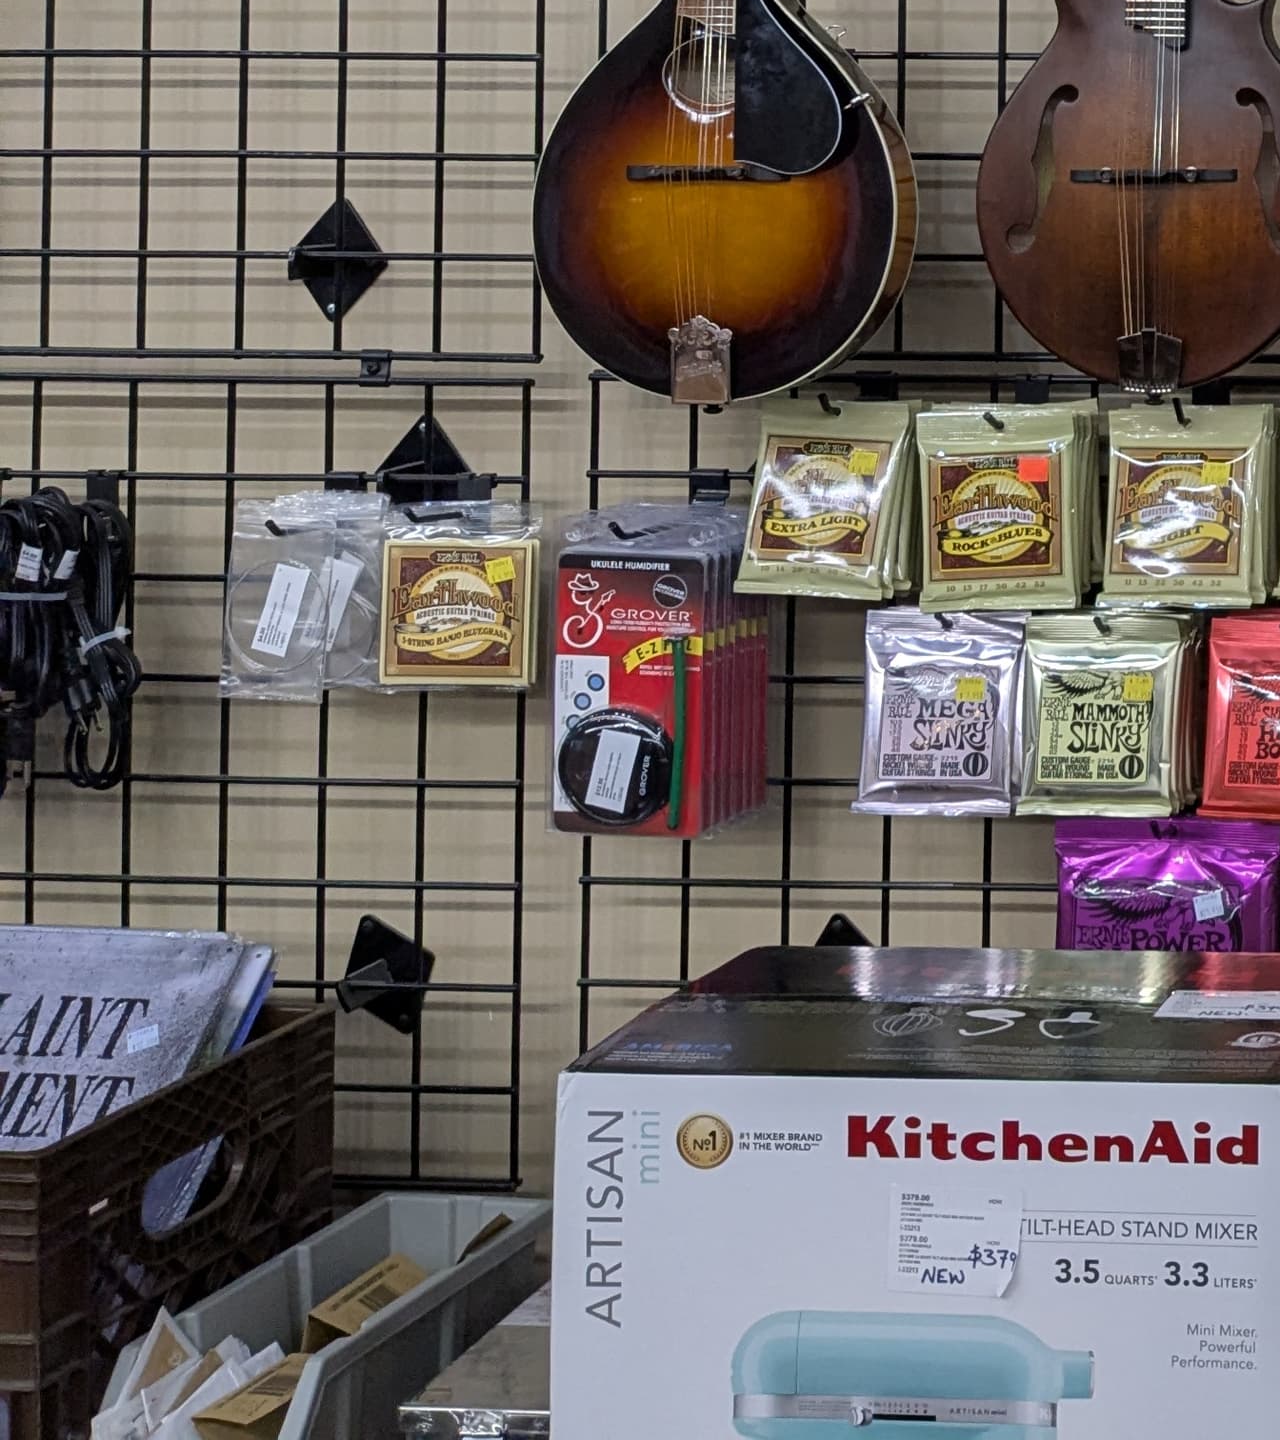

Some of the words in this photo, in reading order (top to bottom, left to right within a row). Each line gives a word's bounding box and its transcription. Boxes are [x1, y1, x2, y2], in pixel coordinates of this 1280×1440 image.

[591, 560, 623, 569] UKULELE
[625, 561, 670, 571] HUMIDIFIER
[391, 579, 520, 621] Earthwood
[611, 609, 690, 621] GROVER
[919, 698, 990, 720] MEGA
[1072, 703, 1149, 722] MAMMOTH
[910, 719, 990, 750] SLINKY
[1067, 722, 1144, 753] SLINKY
[639, 756, 650, 796] GROVER
[1130, 928, 1229, 952] POWER
[631, 1111, 661, 1184] mini
[739, 1132, 750, 1140] #1
[753, 1133, 785, 1141] MIXER
[788, 1134, 822, 1142] BRAND
[739, 1142, 749, 1150] IN
[753, 1142, 772, 1150] THE
[847, 1115, 1260, 1165] KitchenAid
[585, 1111, 624, 1328] ARTISAN
[1122, 1221, 1189, 1238] STAND
[1196, 1223, 1258, 1241] MIXER
[968, 1244, 1016, 1272] $379
[921, 1266, 965, 1284] NEW
[1055, 1259, 1100, 1284] 3.5
[1164, 1261, 1209, 1287] 3.3
[1187, 1323, 1215, 1336] Mini
[1219, 1324, 1258, 1338] Mixer.
[1200, 1340, 1256, 1353] Powerful
[1171, 1355, 1257, 1370] Performance.
